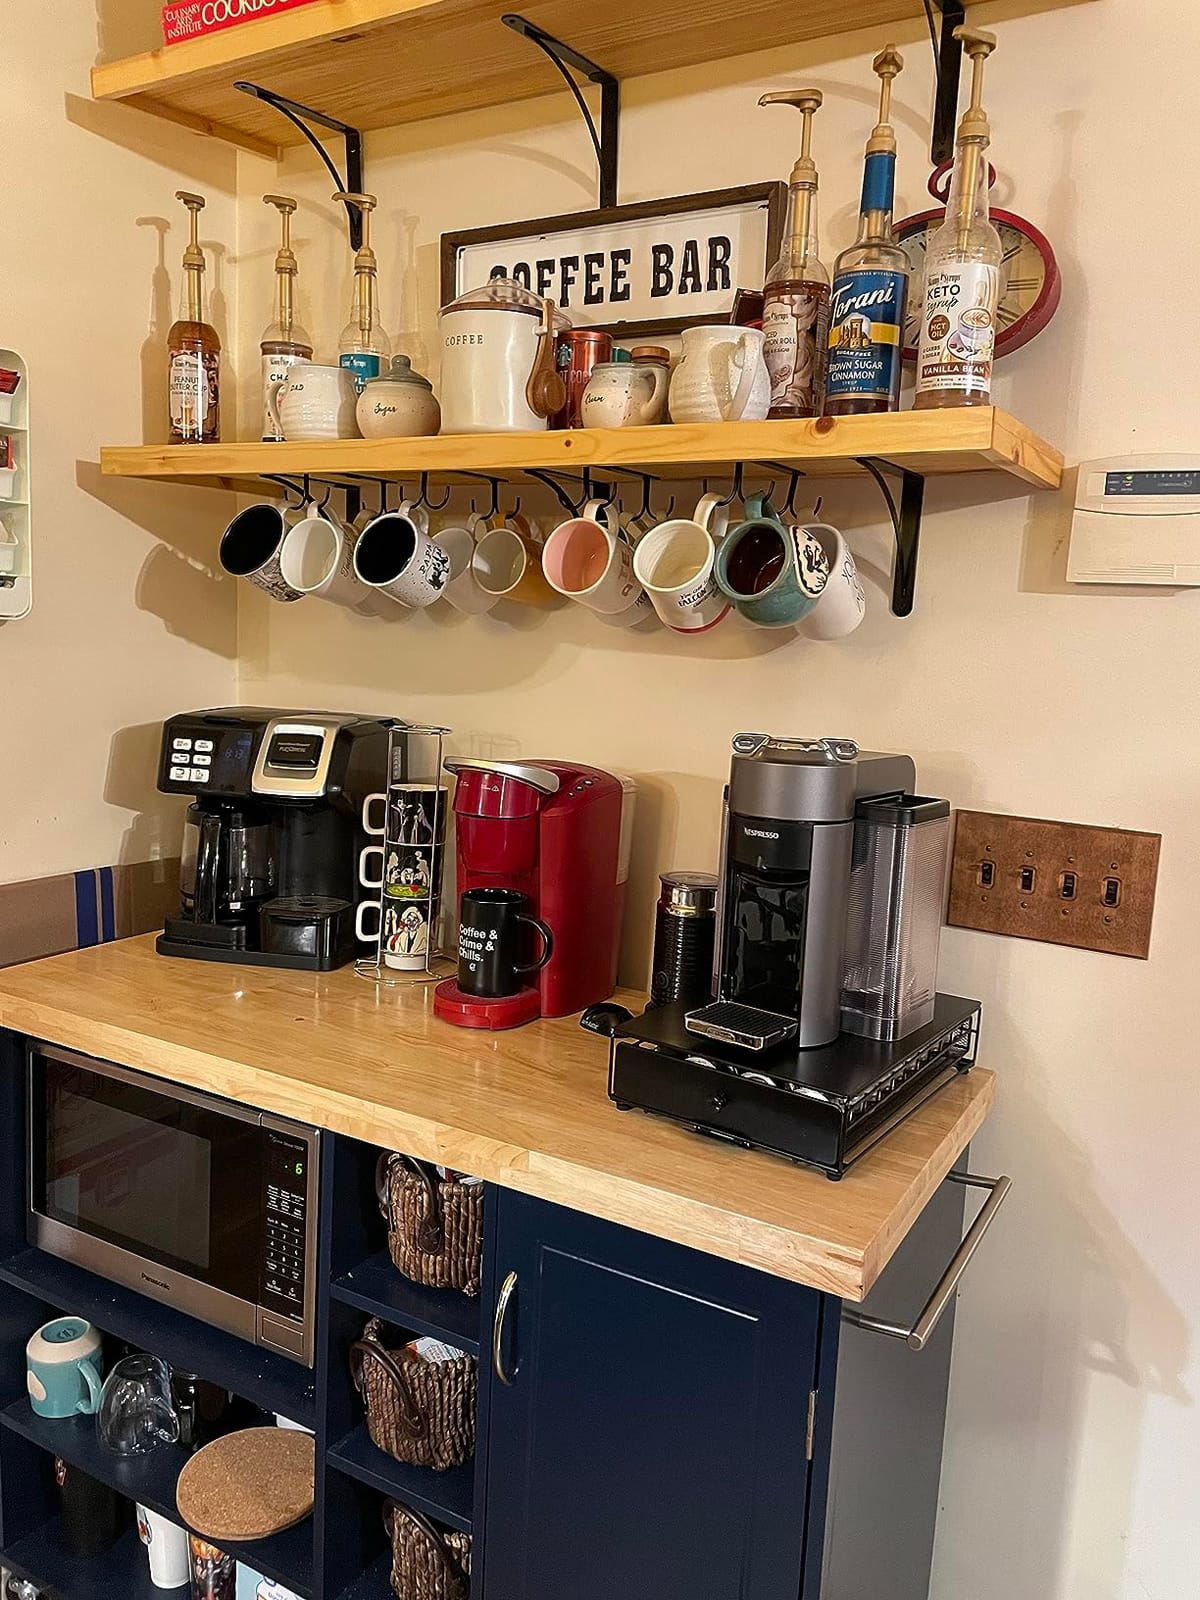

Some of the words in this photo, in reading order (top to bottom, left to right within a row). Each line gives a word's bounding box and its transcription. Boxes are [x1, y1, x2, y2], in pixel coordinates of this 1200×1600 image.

[165, 3, 201, 22] CULINARY
[202, 0, 288, 25] COOK
[168, 20, 202, 39] INSTITUTE
[650, 236, 732, 298] BAR
[927, 284, 960, 300] KETO
[831, 281, 896, 328] Torani
[926, 296, 959, 320] syrup
[446, 334, 483, 347] COFFEE
[780, 337, 796, 345] ROLL
[931, 330, 943, 338] OIL
[854, 360, 883, 370] SUGAR
[924, 364, 960, 375] VANILLA
[831, 370, 875, 382] CINNAMON
[374, 403, 398, 417] Sugar
[419, 543, 432, 575] PAPA
[460, 923, 487, 939] Coffee
[489, 929, 498, 940] &
[459, 935, 483, 950] Crime
[485, 940, 495, 951] &
[459, 946, 485, 962] Chills.
[295, 1162, 303, 1175] 6
